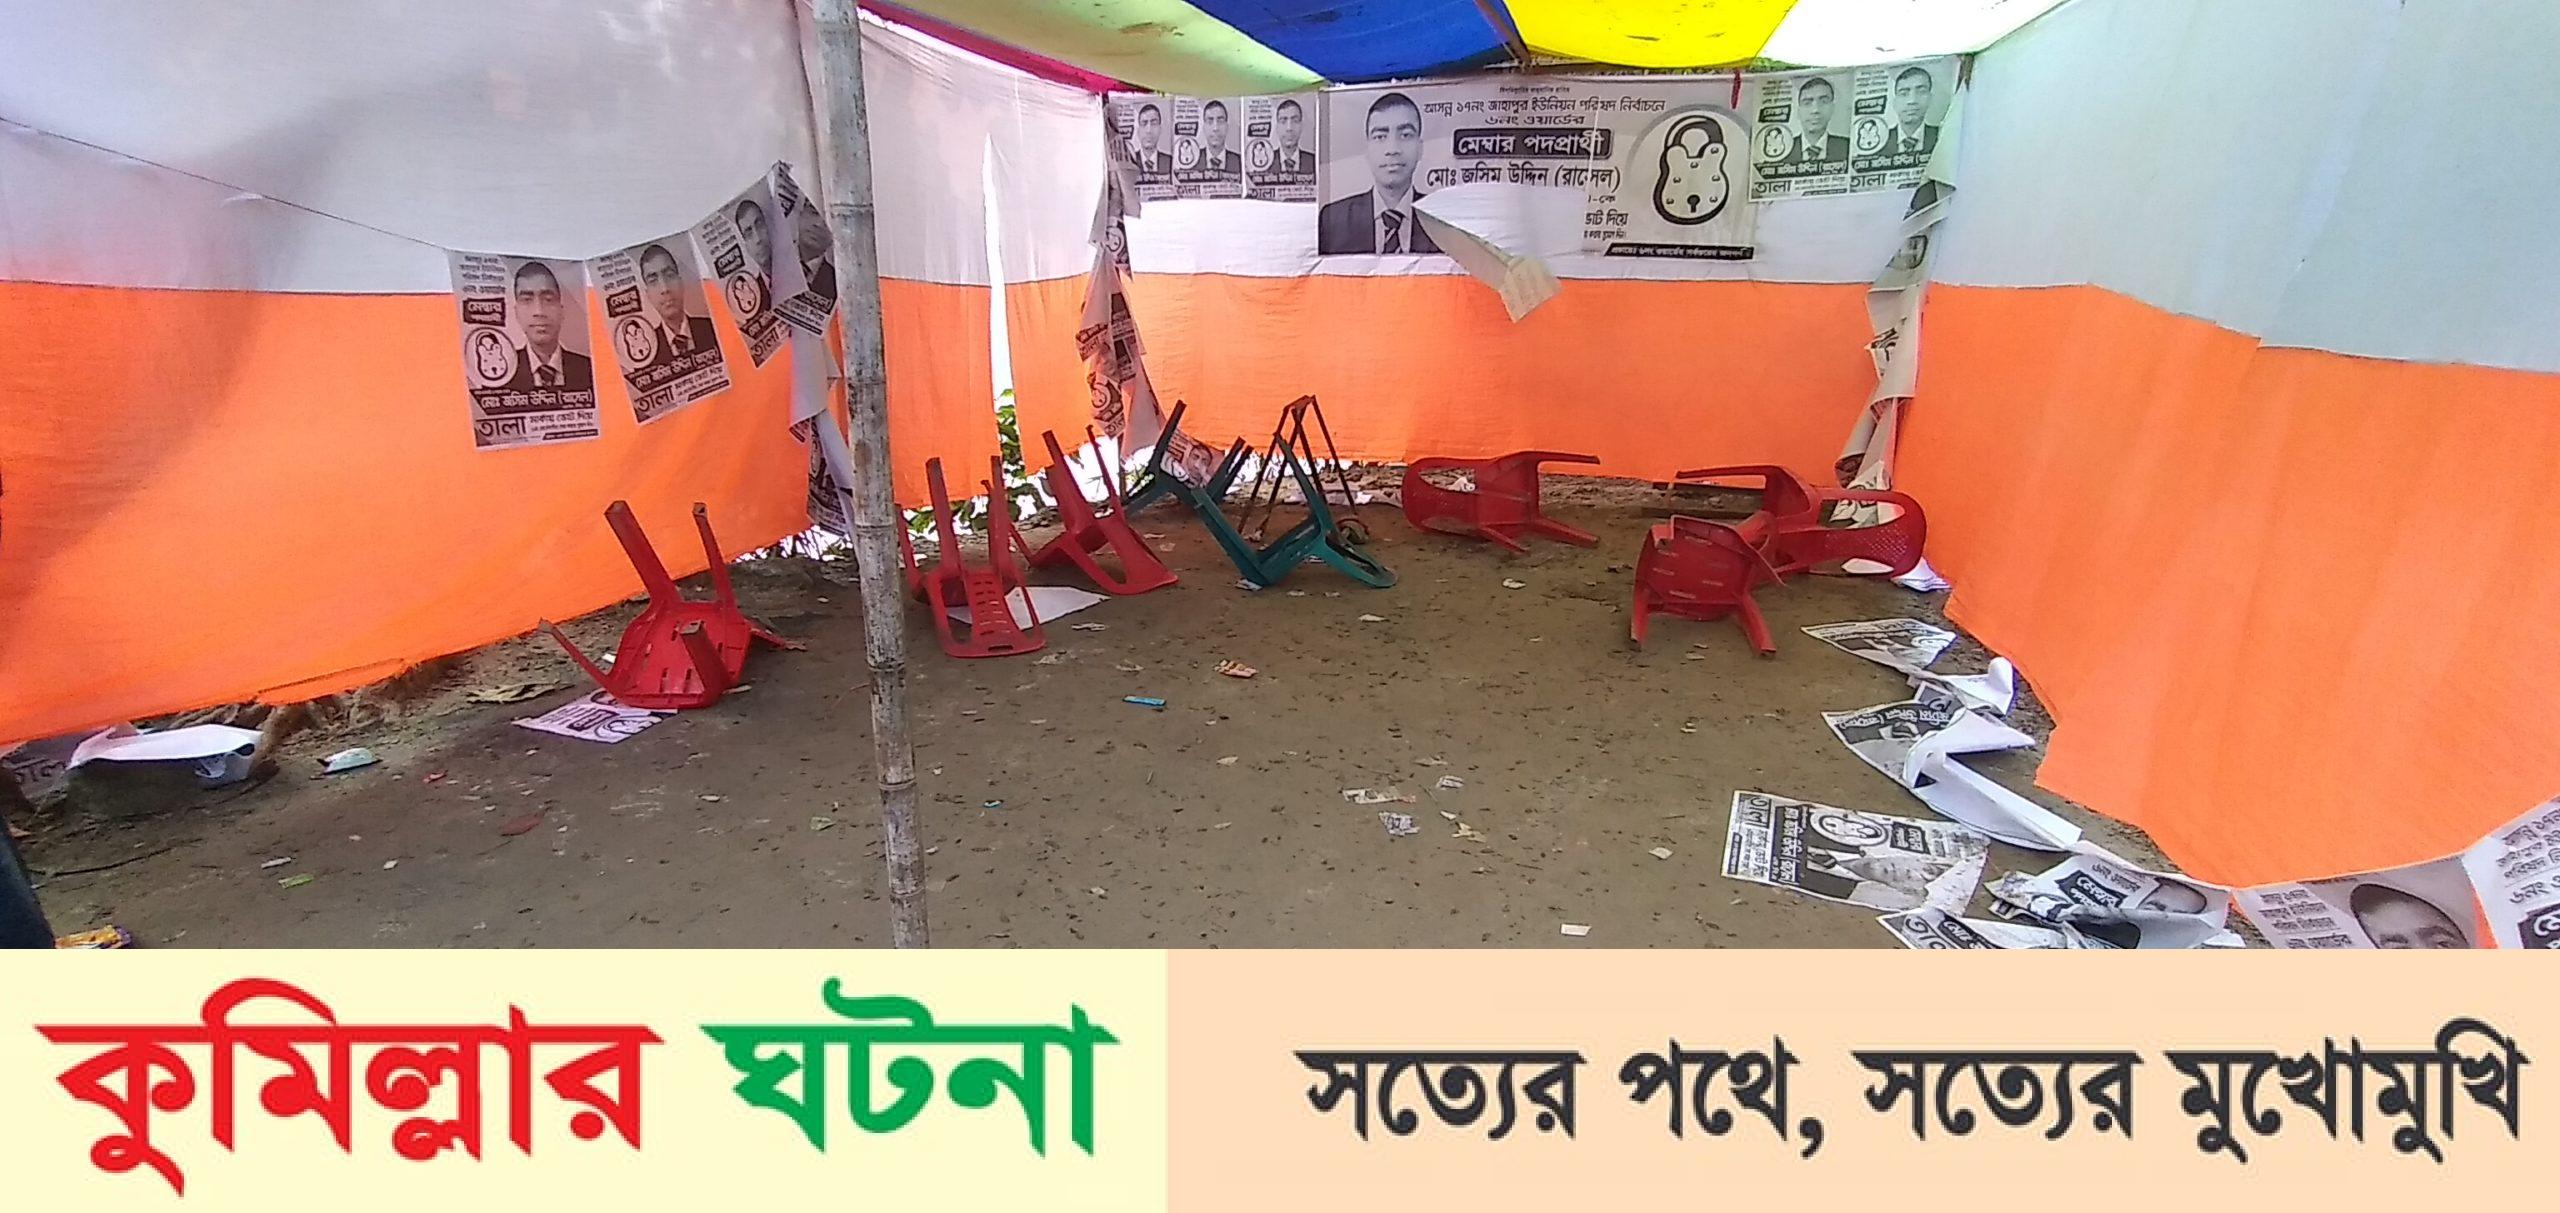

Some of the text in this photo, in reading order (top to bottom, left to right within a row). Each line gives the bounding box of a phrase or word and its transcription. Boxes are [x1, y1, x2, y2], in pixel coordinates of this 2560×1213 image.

[1457, 134, 1516, 155] মেম্বার
[1427, 168, 1457, 187] মোঃ
[1461, 161, 1501, 184] জসিম
[1507, 161, 1549, 187] উদ্দিন
[476, 416, 526, 437] তালা
